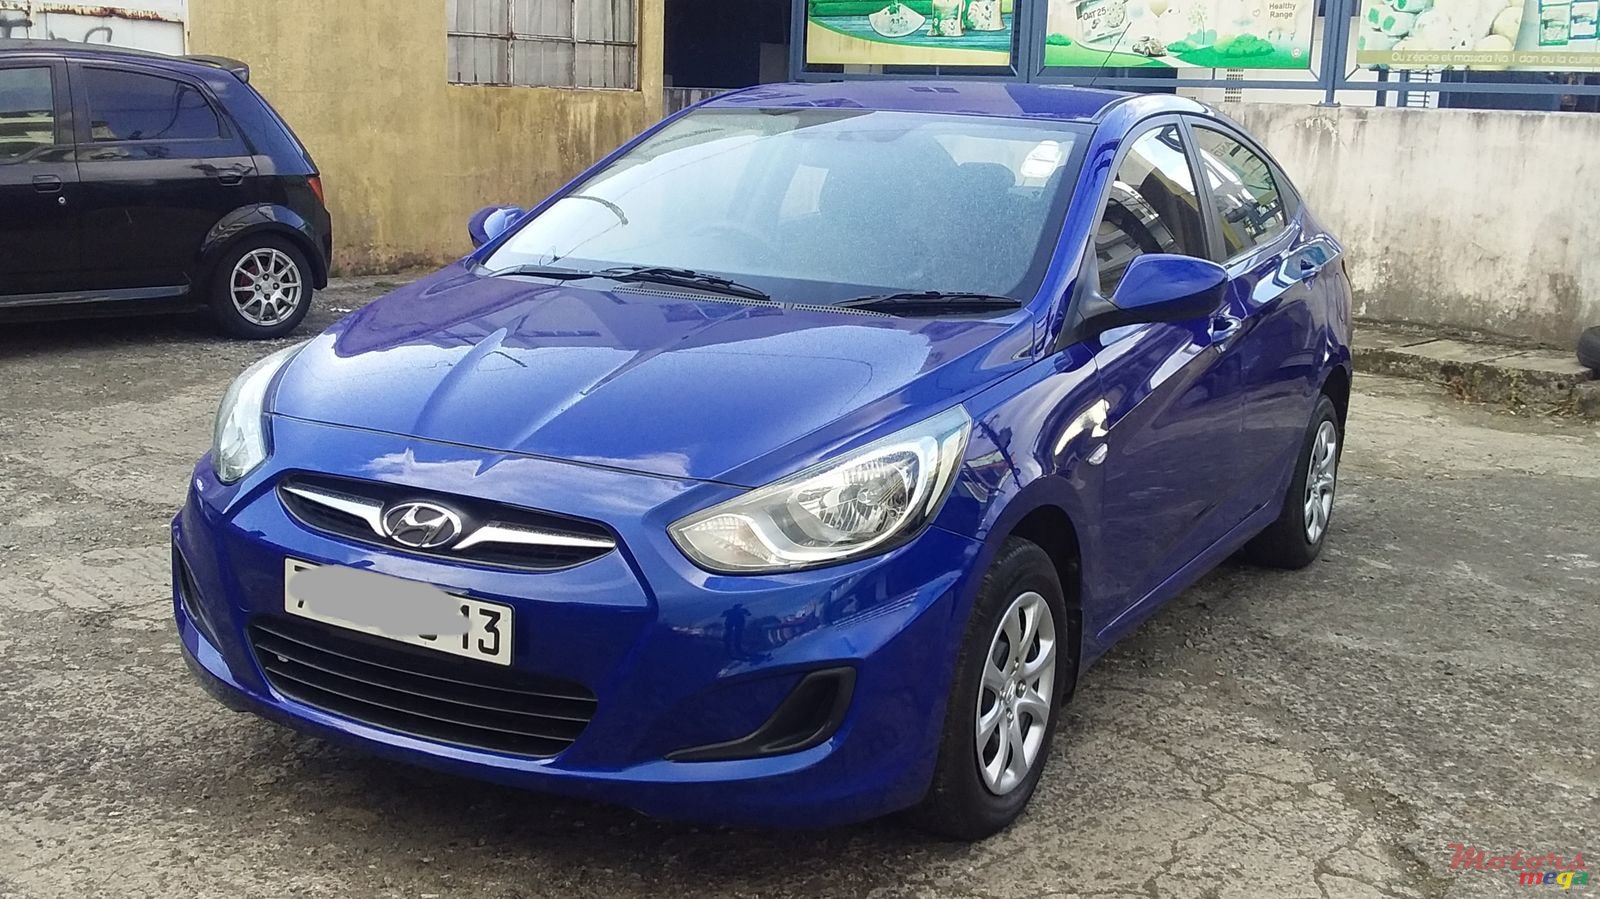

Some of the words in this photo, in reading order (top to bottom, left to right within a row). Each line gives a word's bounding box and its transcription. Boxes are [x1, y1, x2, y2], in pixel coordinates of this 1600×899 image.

[1269, 2, 1297, 11] Healthy
[1270, 10, 1293, 20] Range
[460, 605, 502, 656] 13
